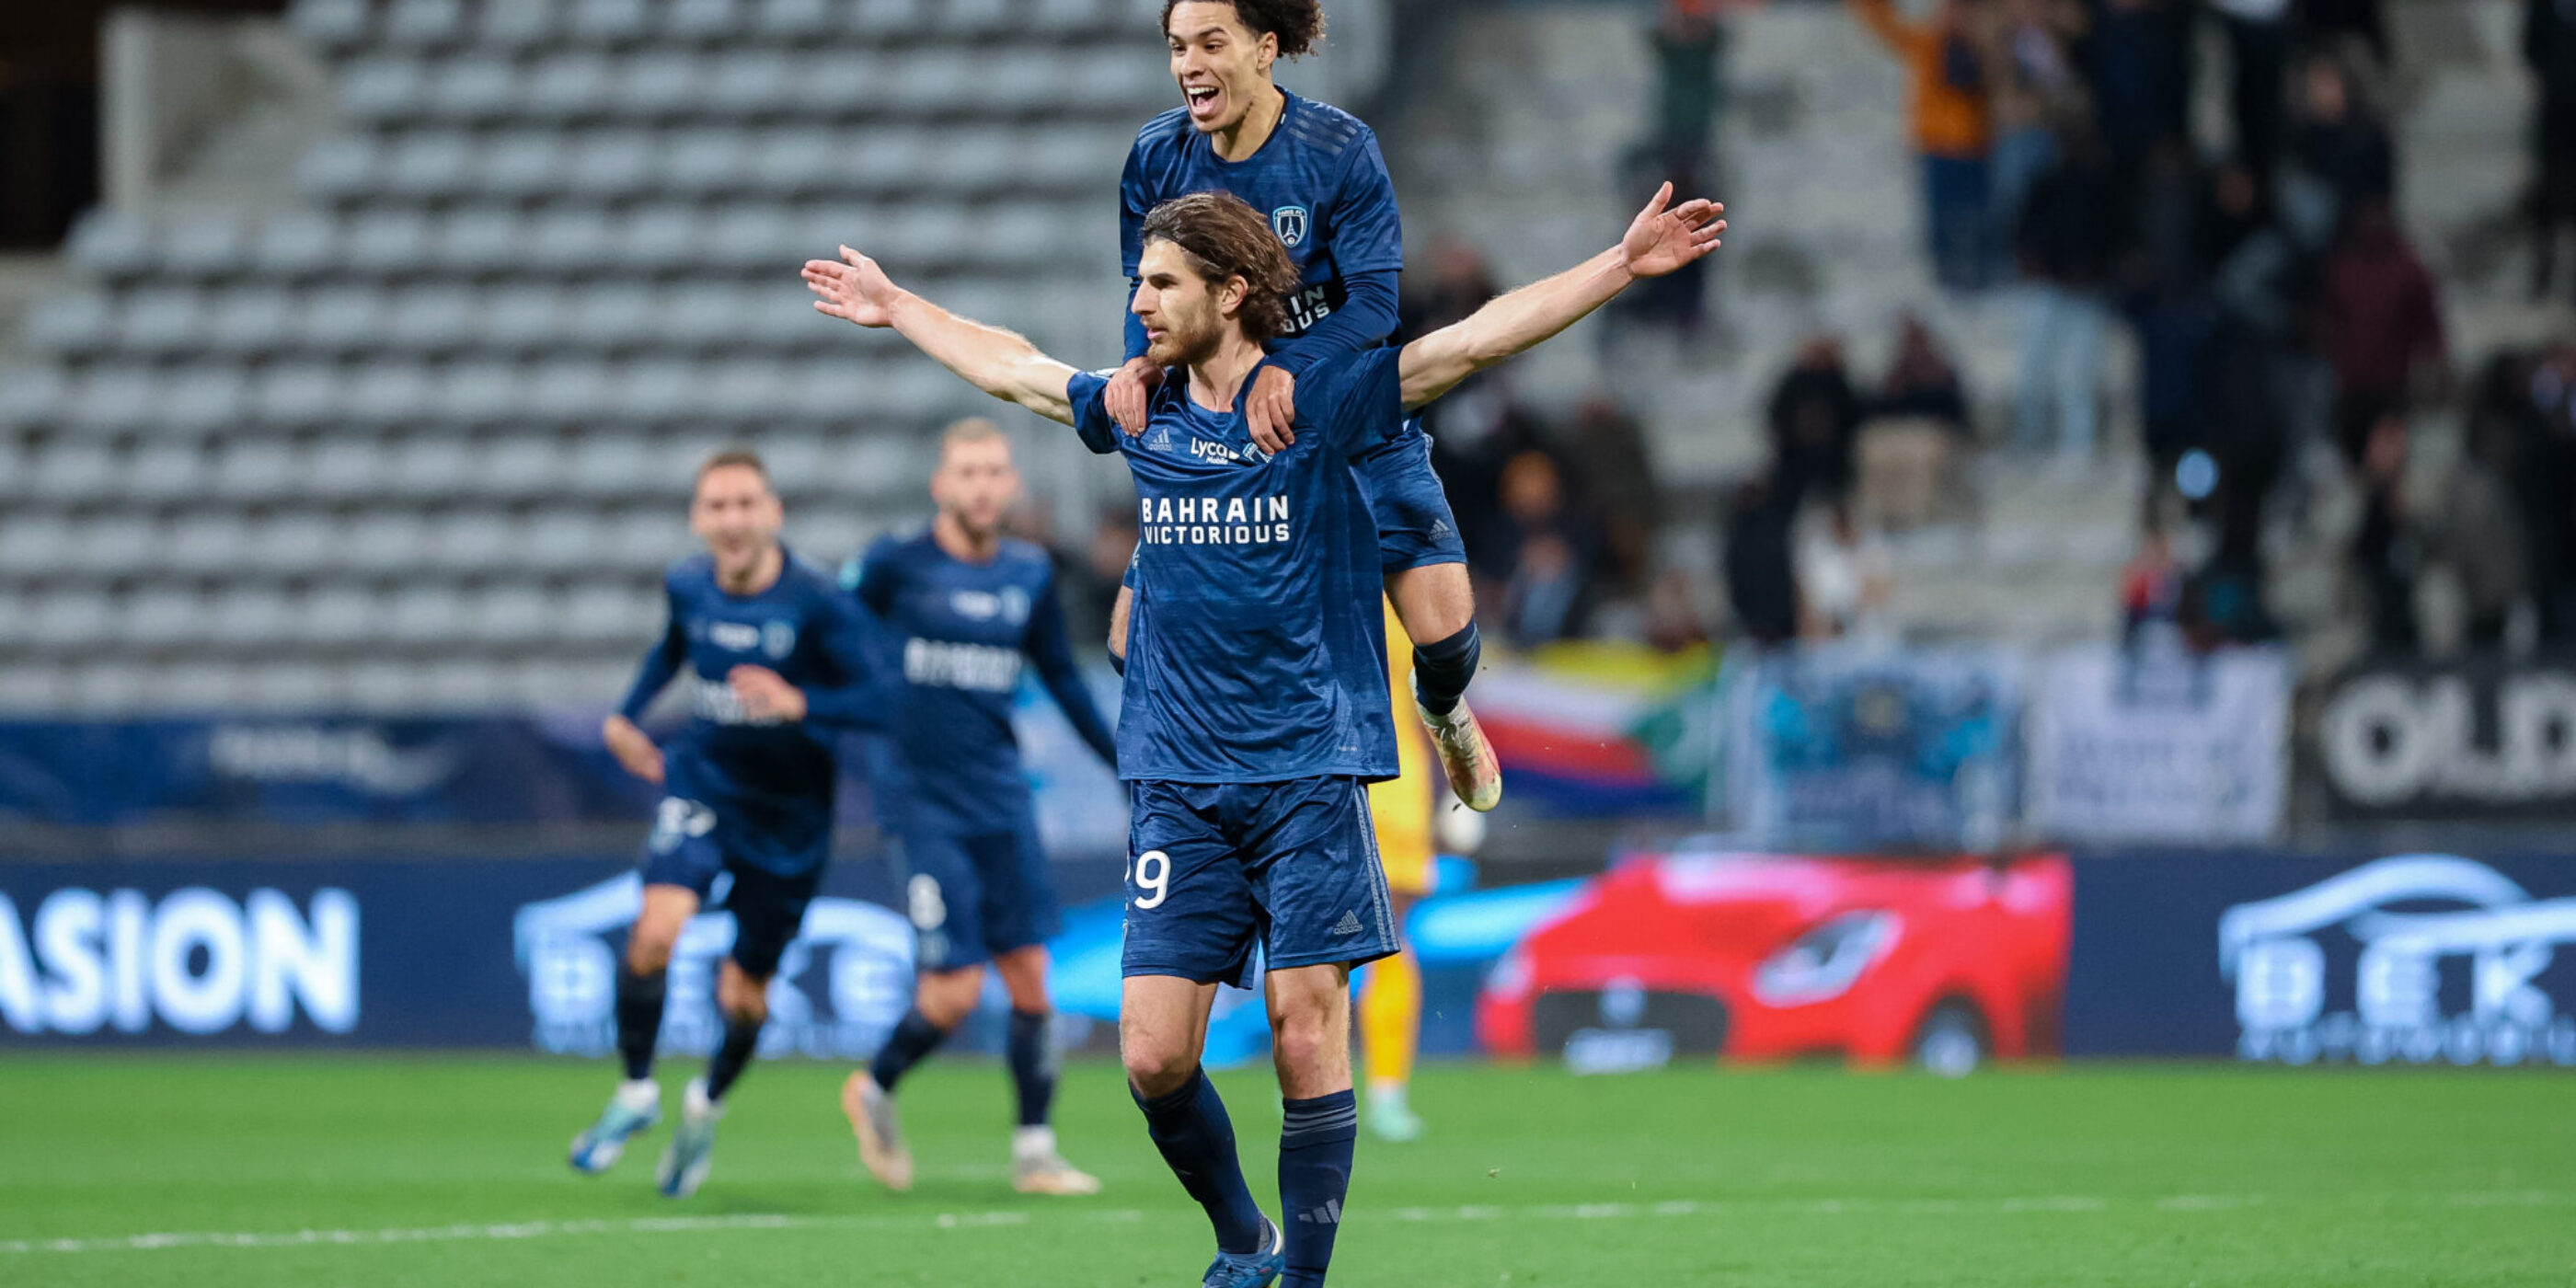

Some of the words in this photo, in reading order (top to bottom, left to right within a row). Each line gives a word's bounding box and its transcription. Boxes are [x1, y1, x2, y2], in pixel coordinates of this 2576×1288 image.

[1190, 437, 1227, 458] Lyca
[1206, 455, 1229, 465] Mobile
[1142, 495, 1288, 523] BAHRAIN
[1144, 523, 1290, 545] VICTORIOUS
[1124, 850, 1170, 910] 9
